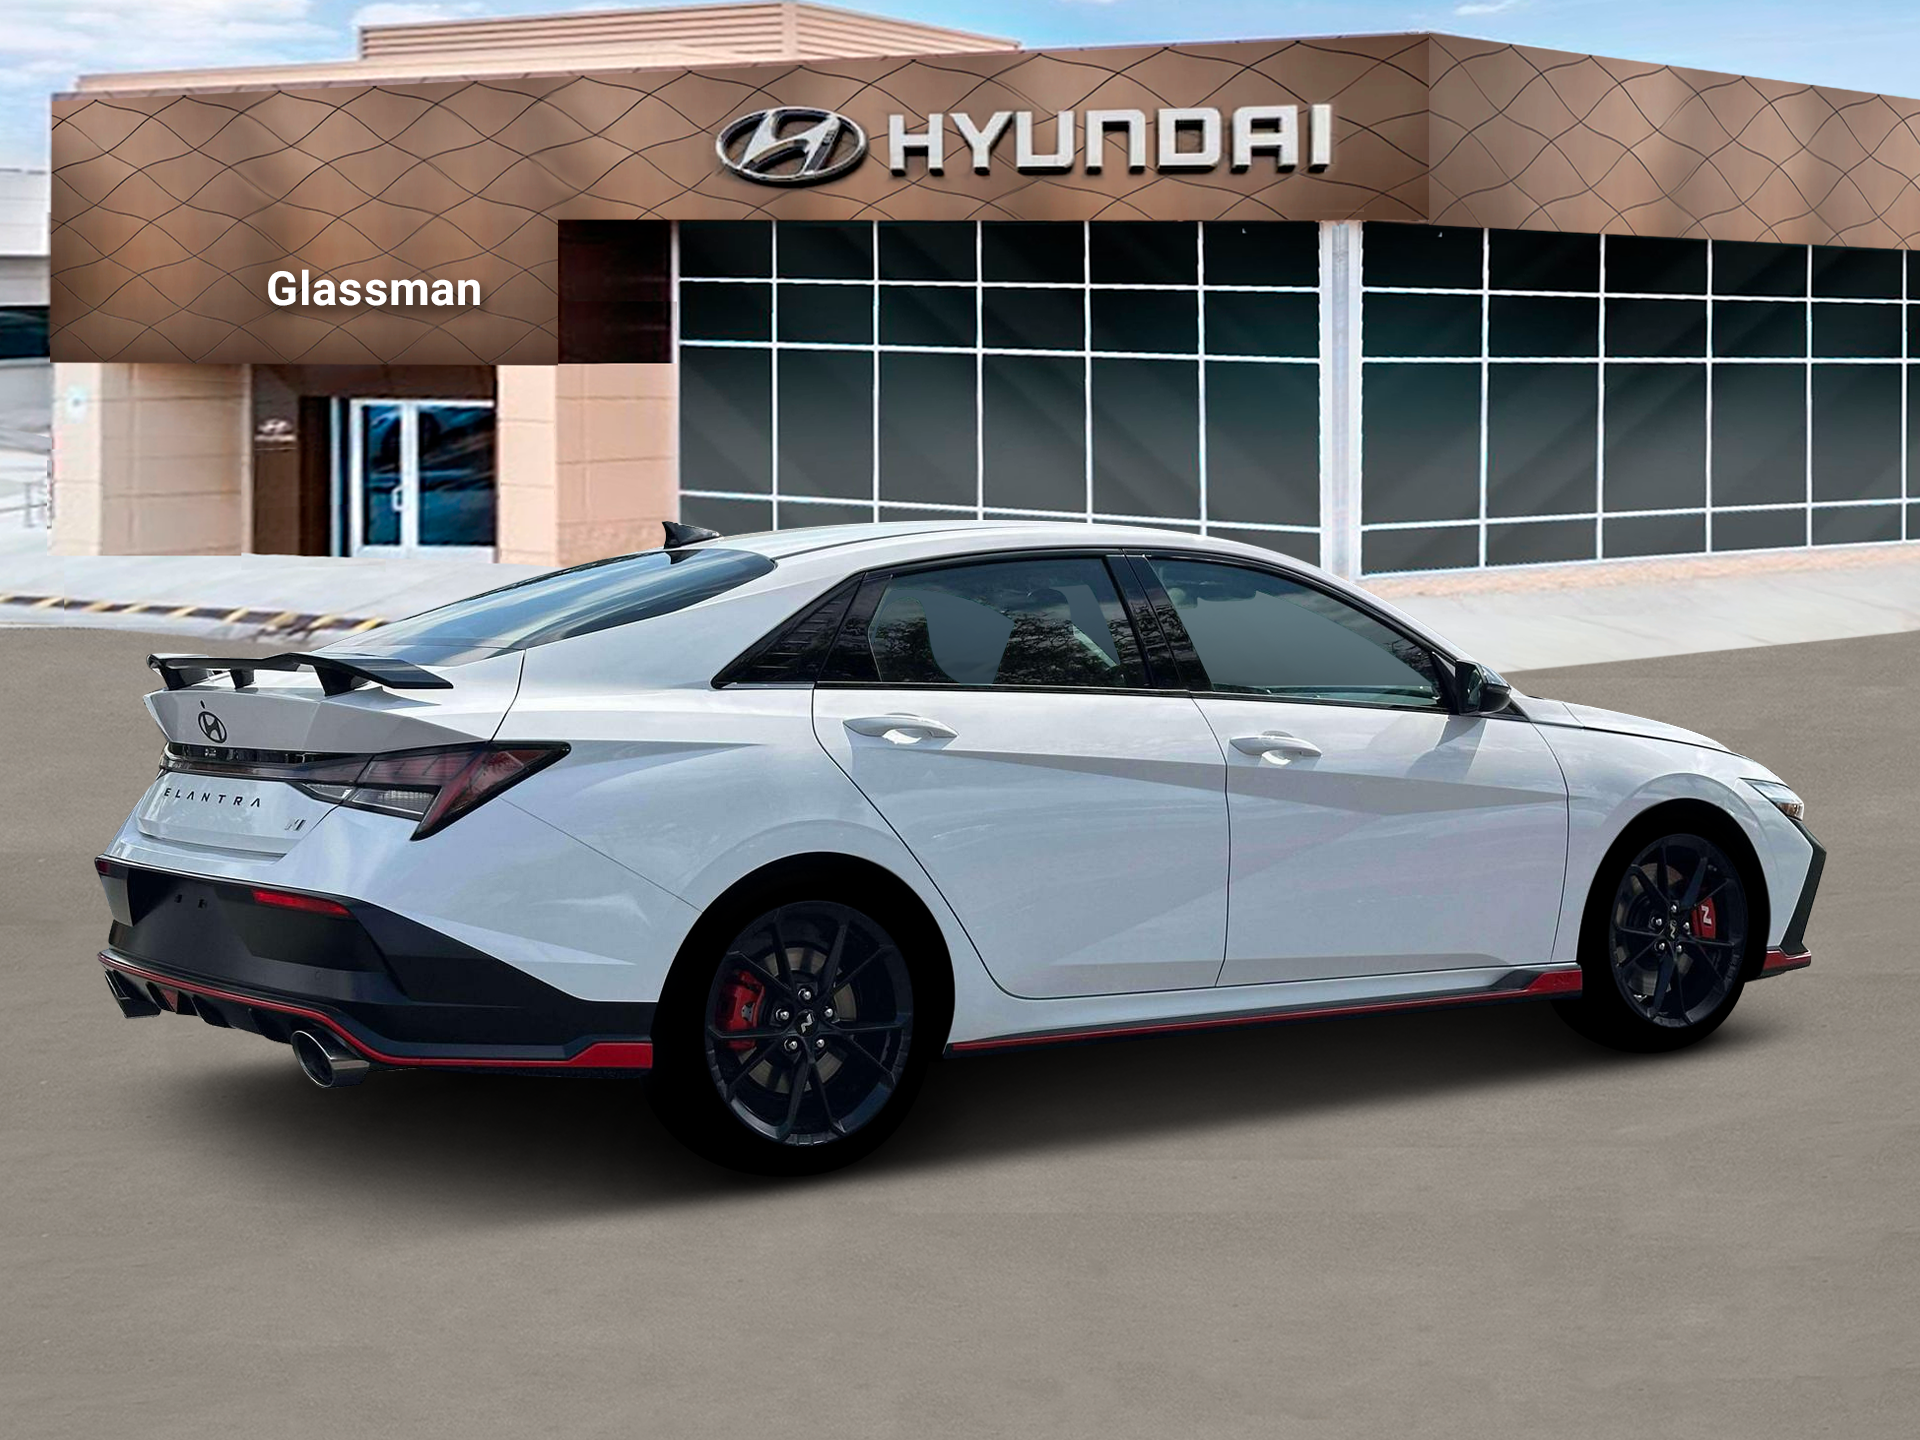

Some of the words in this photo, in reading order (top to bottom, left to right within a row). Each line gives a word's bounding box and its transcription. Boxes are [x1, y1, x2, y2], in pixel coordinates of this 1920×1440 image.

[888, 104, 1332, 171] HYUNDAI
[267, 269, 481, 306] Glassman
[163, 787, 261, 808] ELANTRA
